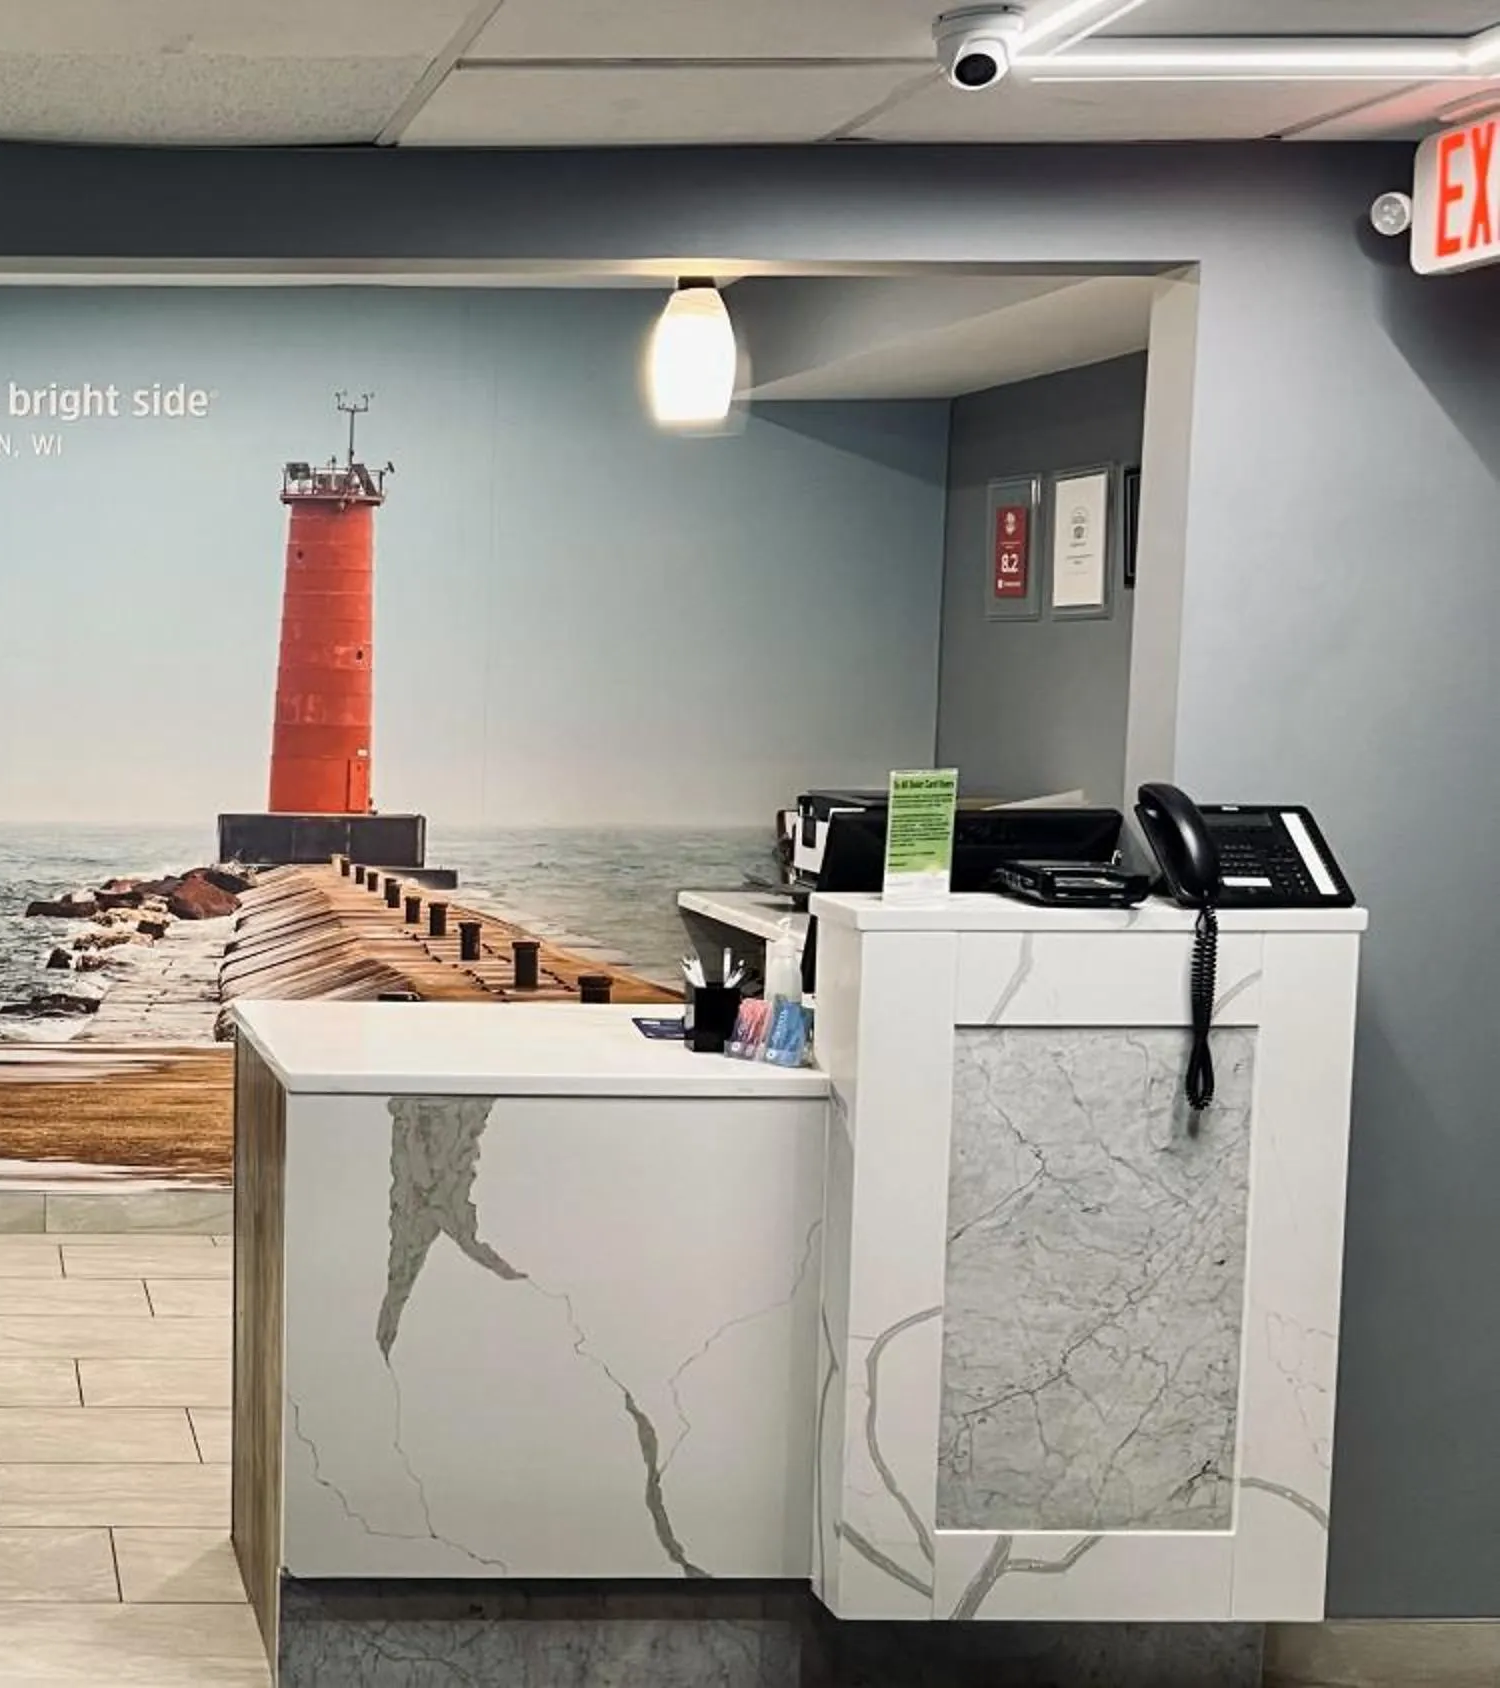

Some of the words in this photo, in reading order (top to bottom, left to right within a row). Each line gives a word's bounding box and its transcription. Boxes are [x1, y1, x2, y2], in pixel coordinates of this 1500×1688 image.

[1436, 122, 1500, 256] EX
[8, 382, 119, 421] bright
[132, 382, 209, 416] side
[32, 434, 63, 455] WI
